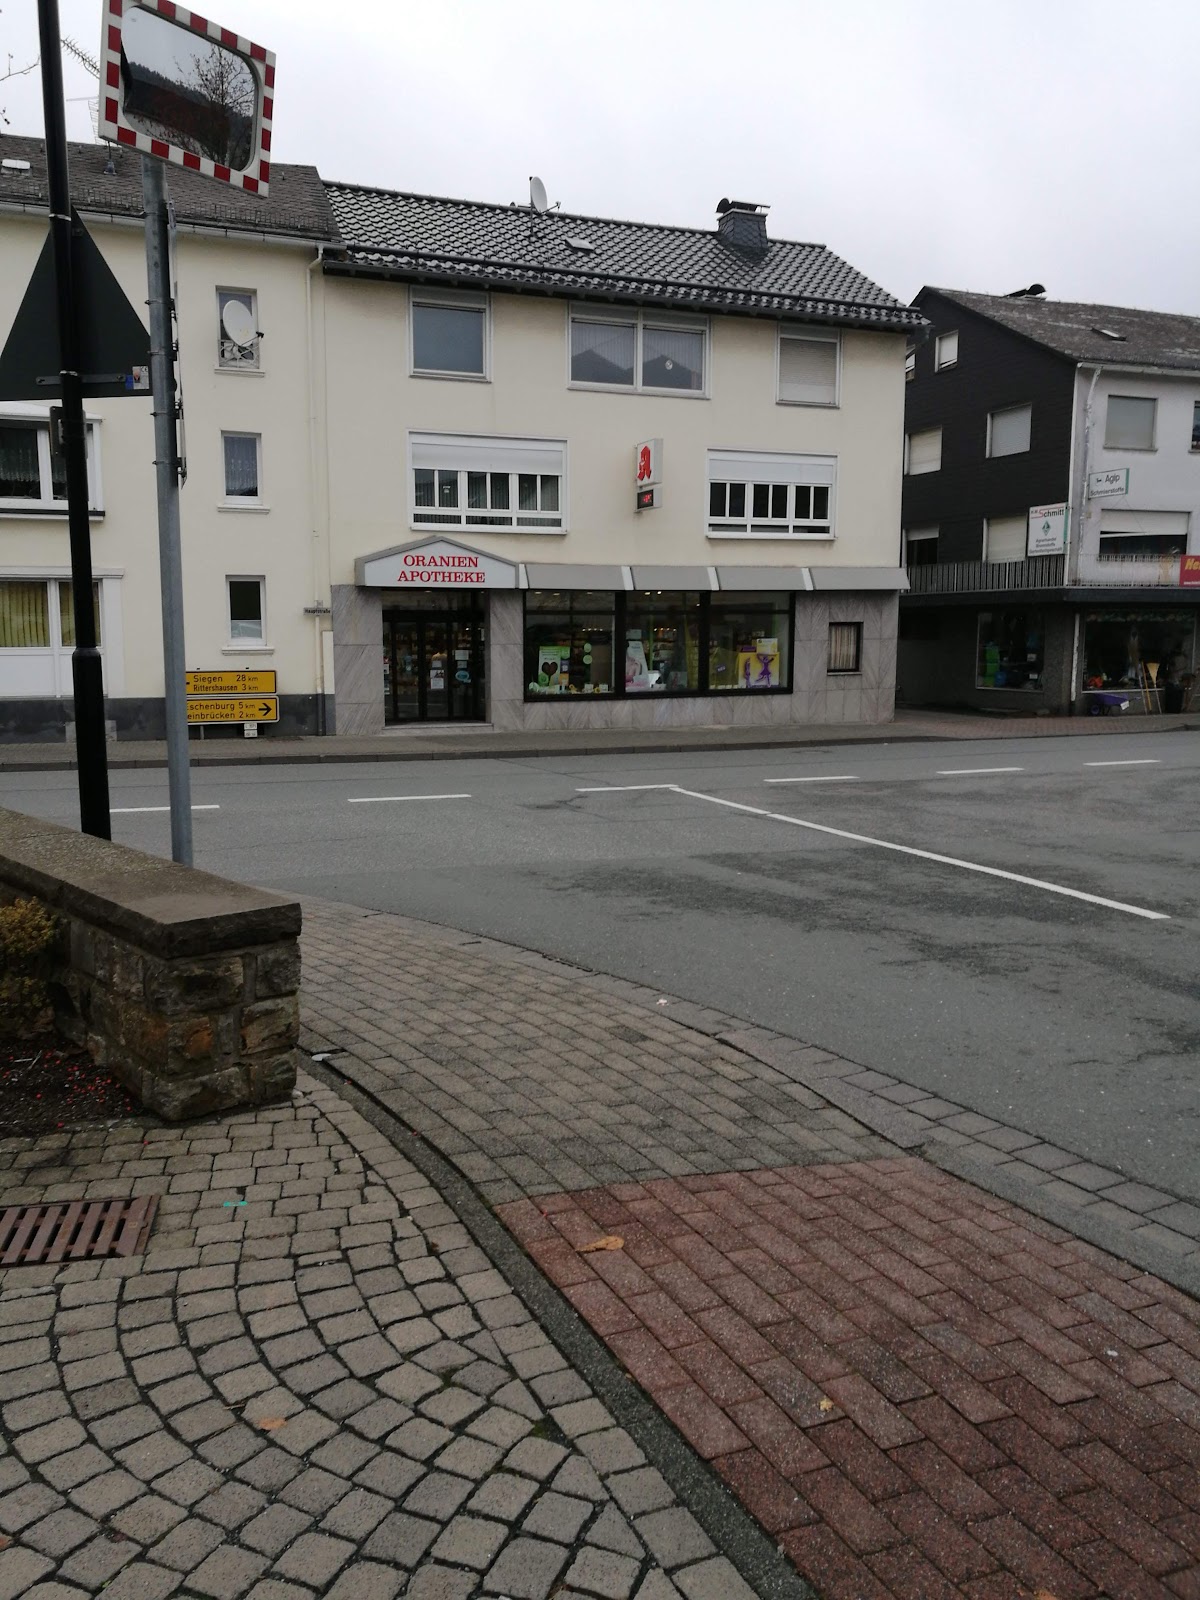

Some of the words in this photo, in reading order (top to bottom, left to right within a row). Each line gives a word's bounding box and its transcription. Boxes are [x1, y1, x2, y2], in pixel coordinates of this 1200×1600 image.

[1105, 474, 1120, 485] Agip
[1039, 508, 1065, 518] Schmitt
[403, 554, 479, 569] ORANIEN
[397, 570, 487, 583] APOTHEKE
[193, 675, 223, 684] Siegen
[236, 674, 247, 682] 28
[193, 684, 238, 692] Rittershausen
